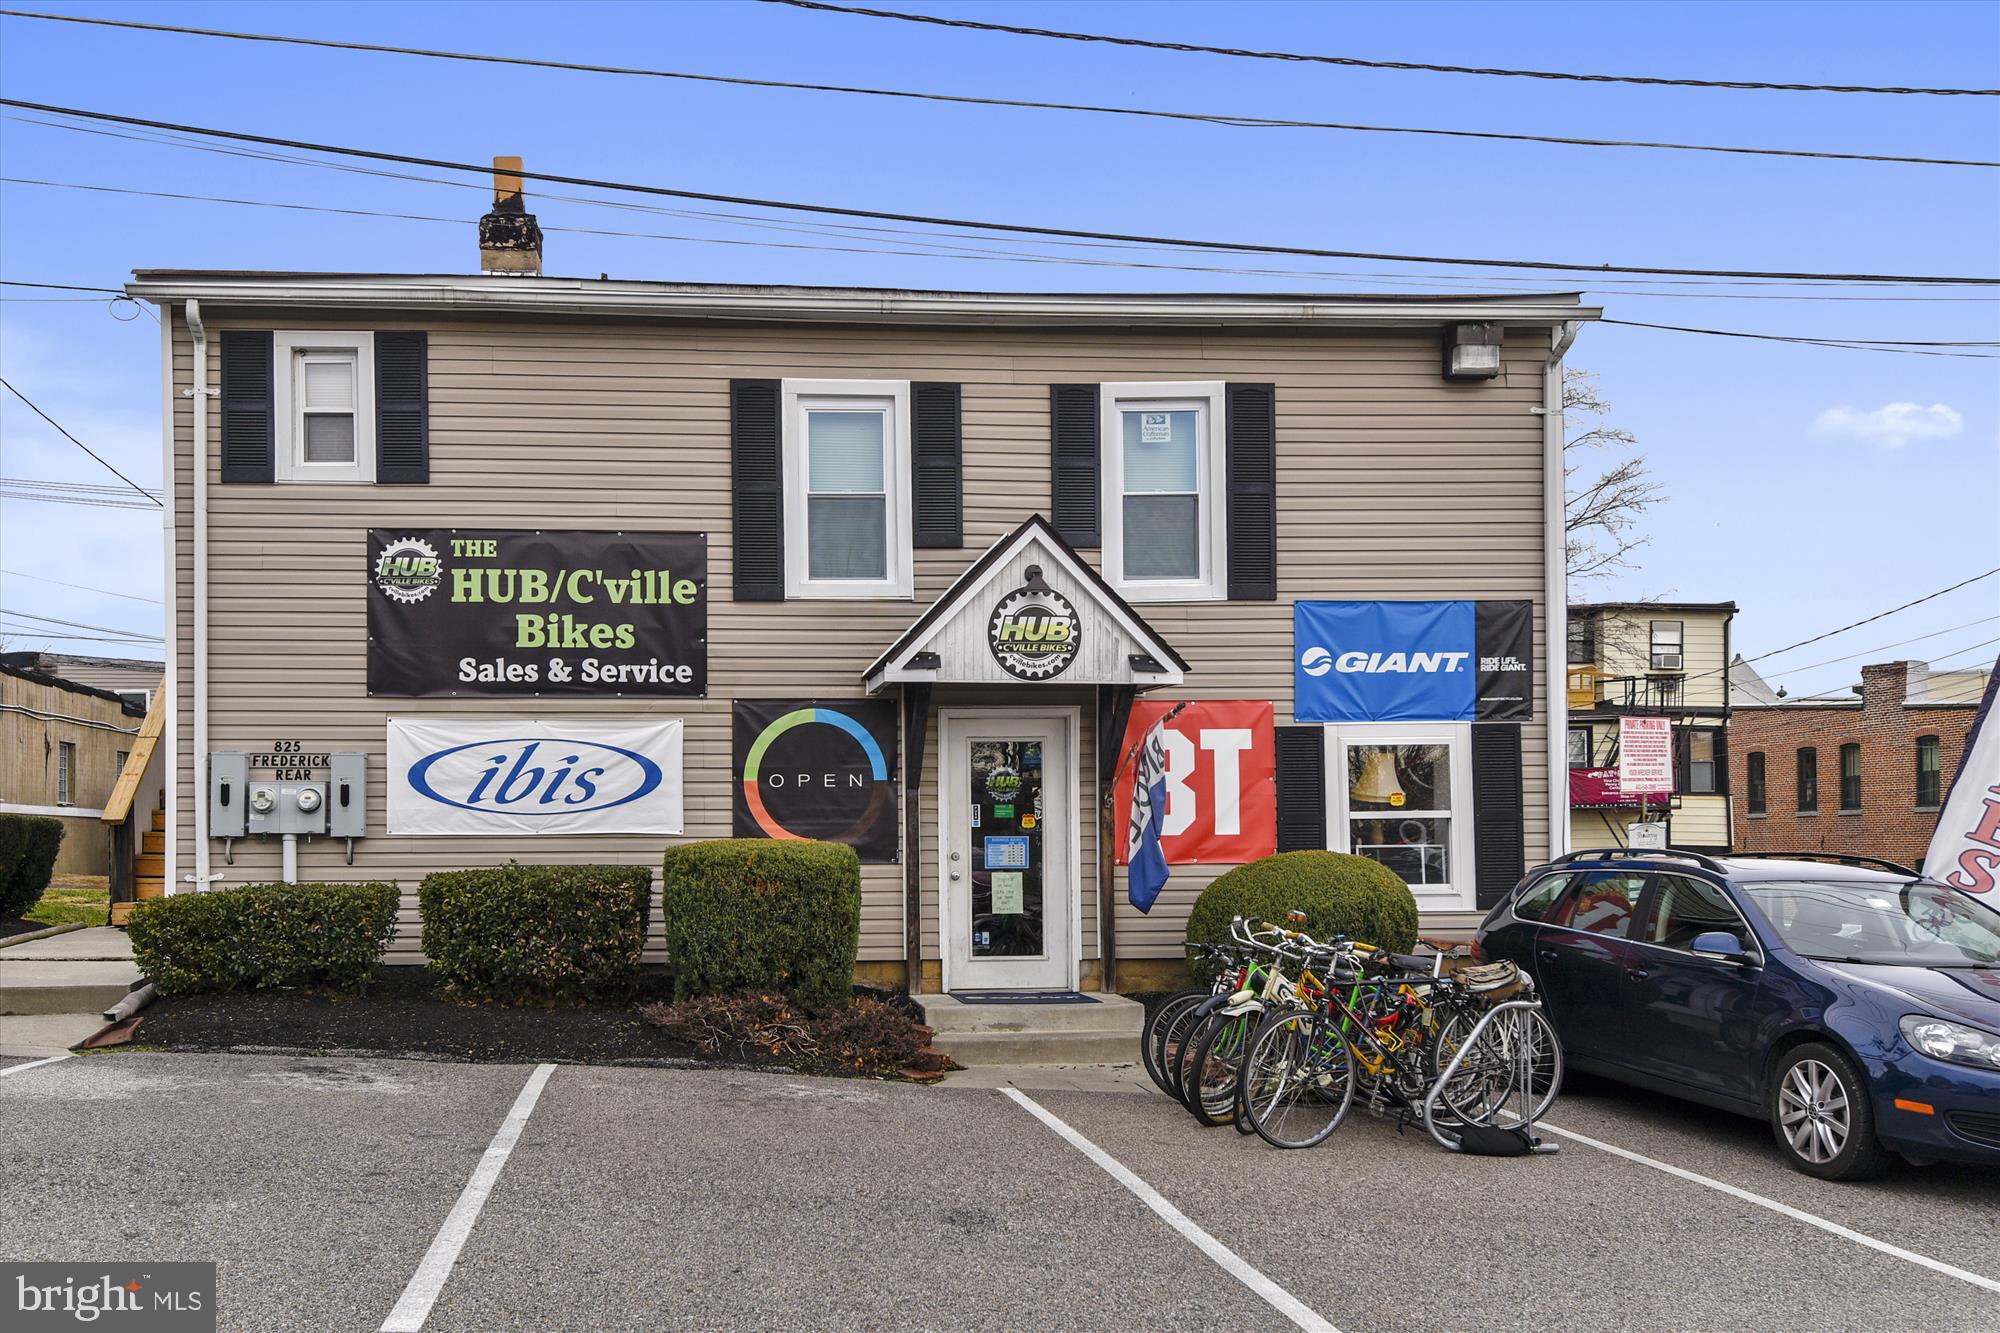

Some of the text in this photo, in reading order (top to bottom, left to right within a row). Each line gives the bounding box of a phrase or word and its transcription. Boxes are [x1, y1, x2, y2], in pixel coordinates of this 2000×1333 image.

[451, 539, 497, 558] THE
[381, 557, 438, 577] HUB
[451, 568, 698, 605] HUB/C'ville
[515, 613, 636, 649] Bikes
[1000, 616, 1071, 641] HUB
[1003, 643, 1068, 652] C'VILLE BIKES
[1009, 654, 1062, 670] cvillebikes.com
[1335, 652, 1469, 673] GIANT
[1480, 656, 1500, 665] RIDE
[1480, 664, 1500, 672] RIDE
[458, 658, 694, 683] Sales & Service
[274, 741, 301, 752] 825
[252, 755, 330, 767] FREDERICK
[275, 769, 312, 781] REAR
[466, 742, 605, 805] ibis
[769, 774, 863, 788] OPEN
